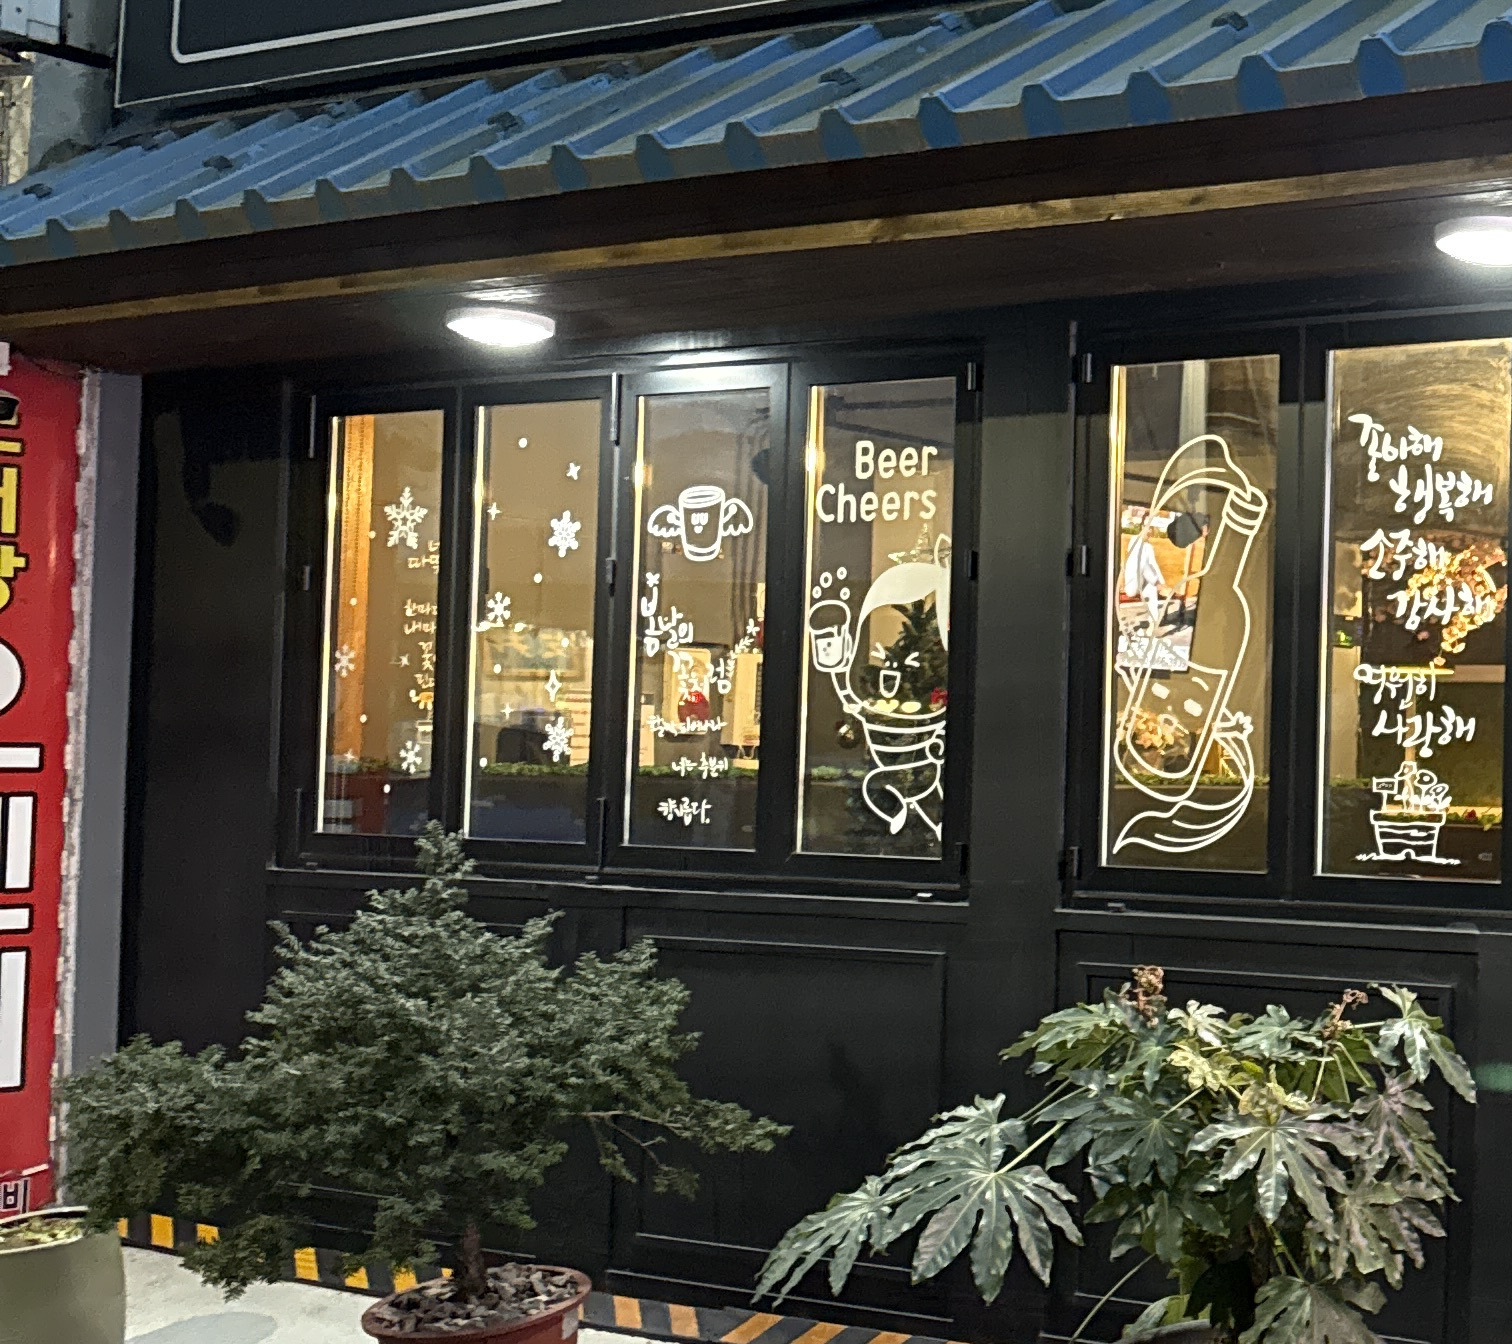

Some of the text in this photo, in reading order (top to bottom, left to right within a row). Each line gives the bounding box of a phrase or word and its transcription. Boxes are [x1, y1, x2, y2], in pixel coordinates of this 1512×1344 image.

[855, 440, 938, 479] Beer
[1348, 413, 1443, 482] 좋아해
[816, 483, 937, 523] Cheers
[1389, 464, 1493, 525] 행복해
[1371, 705, 1476, 757] 사랑해
